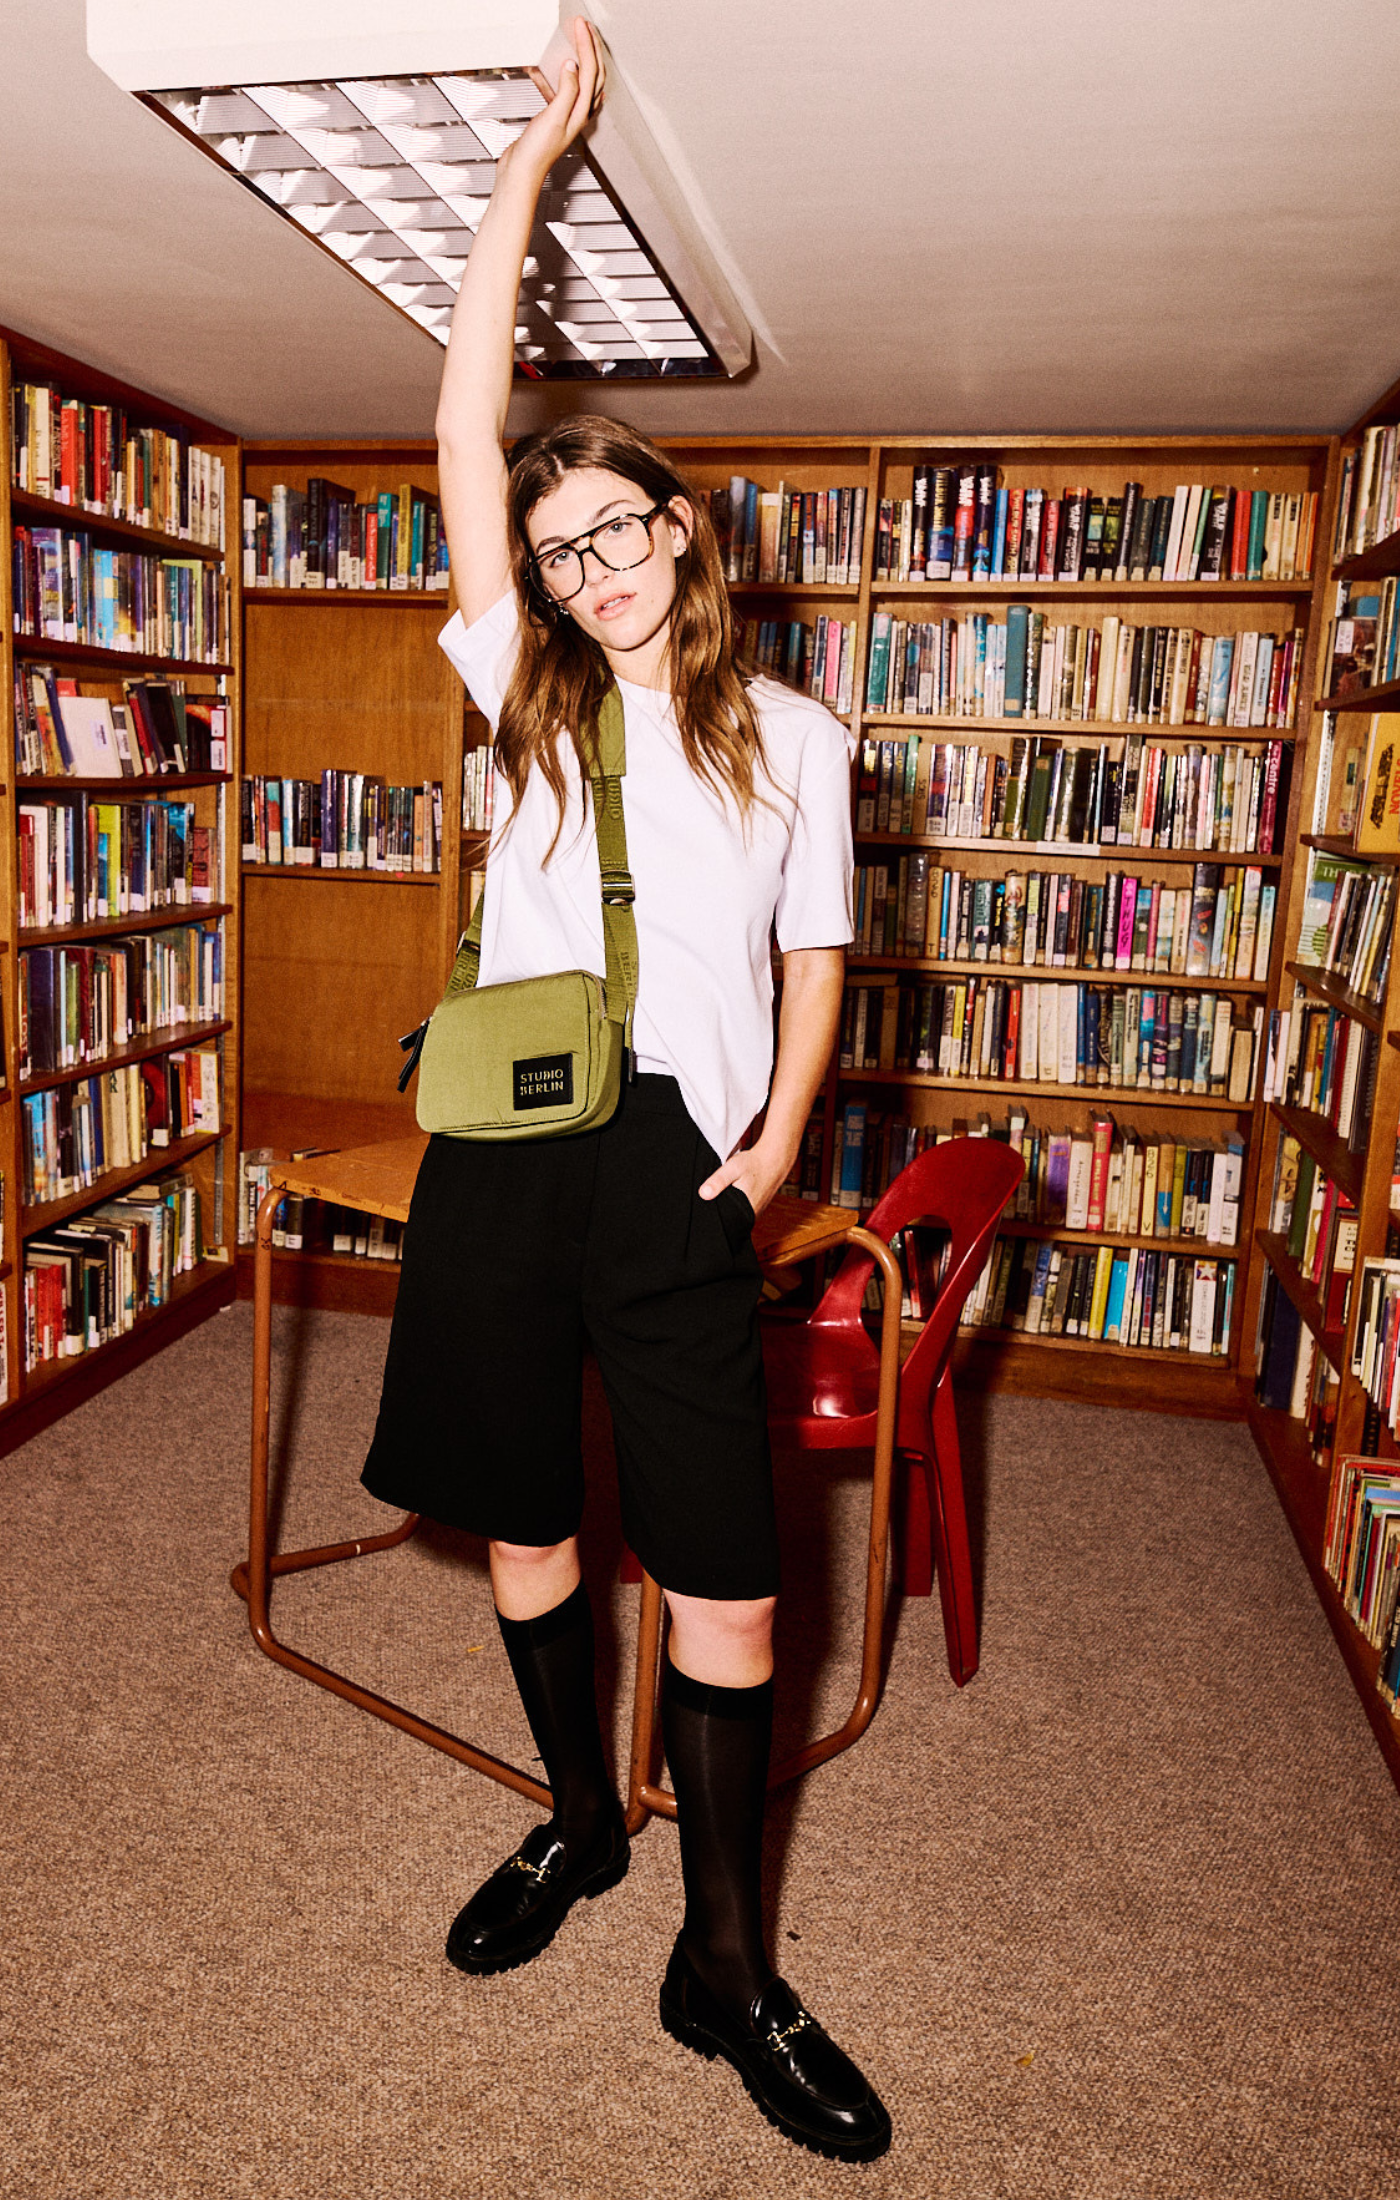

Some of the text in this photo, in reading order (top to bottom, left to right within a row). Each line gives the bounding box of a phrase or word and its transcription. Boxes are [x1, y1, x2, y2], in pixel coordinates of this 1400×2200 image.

[1267, 757, 1278, 795] centre
[1121, 896, 1133, 948] THUG
[519, 1068, 564, 1085] STUDIO
[519, 1080, 564, 1096] BERLIN
